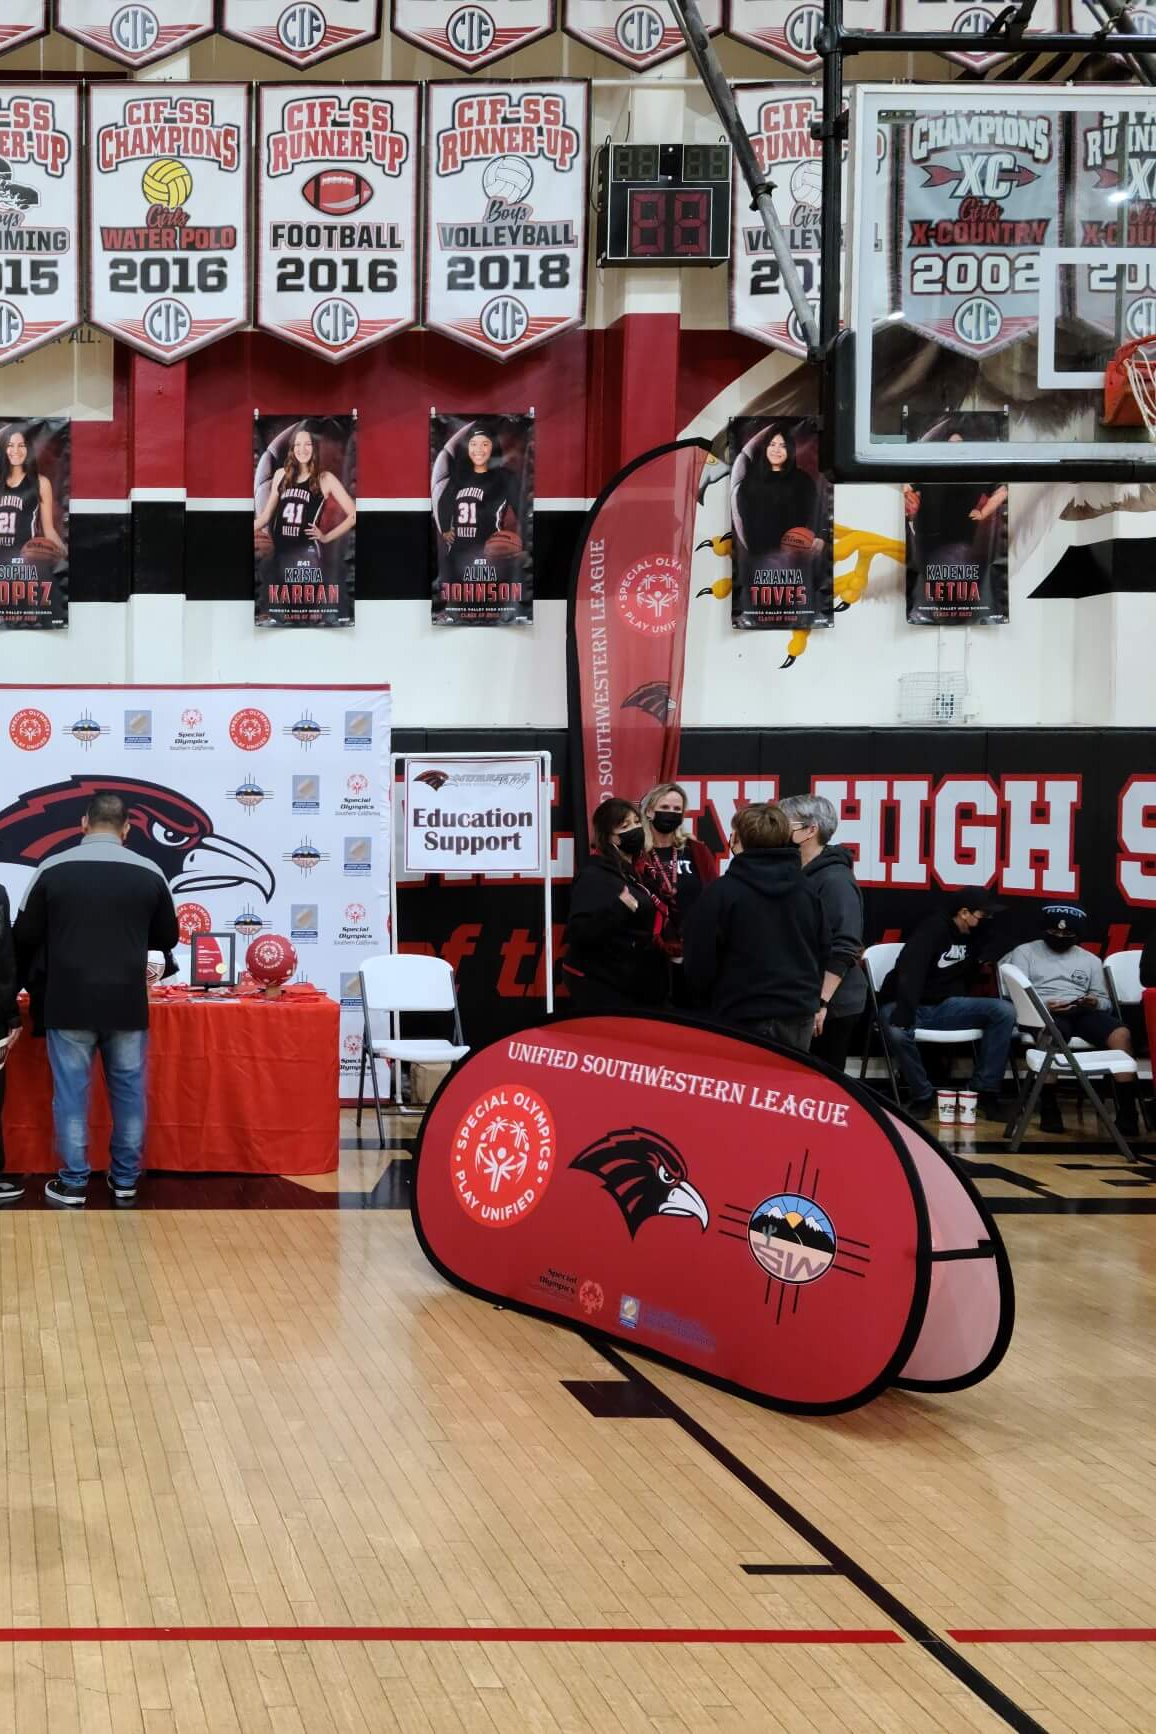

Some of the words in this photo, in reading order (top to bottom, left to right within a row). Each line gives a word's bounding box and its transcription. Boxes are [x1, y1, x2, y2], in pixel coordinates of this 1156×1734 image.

[114, 8, 154, 48] CIF
[283, 8, 322, 46] CIF
[452, 11, 492, 50] CIF
[620, 10, 661, 50] CIF
[128, 101, 211, 126] CIF-SS
[285, 101, 390, 132] CIF-SS
[457, 97, 561, 127] CIF-SS
[98, 125, 238, 169] CHAMPIONS
[273, 131, 405, 173] RUNNER-UP
[442, 126, 575, 171] RUNNER-UP
[912, 115, 1050, 162] CHAMPIONS
[949, 152, 1016, 199] XC
[146, 204, 190, 228] Girls
[487, 198, 529, 223] Boys
[102, 228, 176, 250] WATER
[181, 228, 236, 250] POLO
[271, 223, 403, 249] FOOTBALL
[443, 223, 576, 249] VOLLEYBALL
[911, 221, 1047, 246] X-COUNTRY
[108, 256, 228, 293] 2016
[276, 257, 398, 292] 2016
[447, 255, 570, 291] 2018
[912, 254, 1040, 293] 2002
[148, 301, 189, 341] CIF
[315, 302, 355, 342] CIF
[483, 300, 524, 340] CIF
[957, 301, 999, 342] CIF
[282, 502, 305, 524] 41
[458, 502, 477, 524] 31
[284, 567, 323, 583] KRISTA
[463, 566, 498, 582] ALINA
[590, 538, 605, 621] LEAGUE
[619, 560, 652, 601] SPECIAL
[753, 568, 804, 585] ARIANNA
[926, 564, 980, 581] KADENCE
[441, 582, 523, 603] JOHNSON
[749, 585, 807, 608] TOVES
[924, 581, 981, 602] LETUA
[625, 611, 650, 630] PLAY
[592, 627, 614, 787] SOUTHWESTERN
[412, 807, 533, 828] Education
[423, 830, 522, 856] Support
[812, 776, 1082, 896] HIGH
[507, 1041, 579, 1070] UNIFIED
[579, 1054, 747, 1105] SOUTHWESTERN
[749, 1086, 850, 1128] LEAGUE
[457, 1091, 508, 1150] SPECIAL
[513, 1092, 551, 1171] OLYMPICS
[455, 1169, 480, 1209] PLAY
[481, 1188, 535, 1221] UNIFIED
